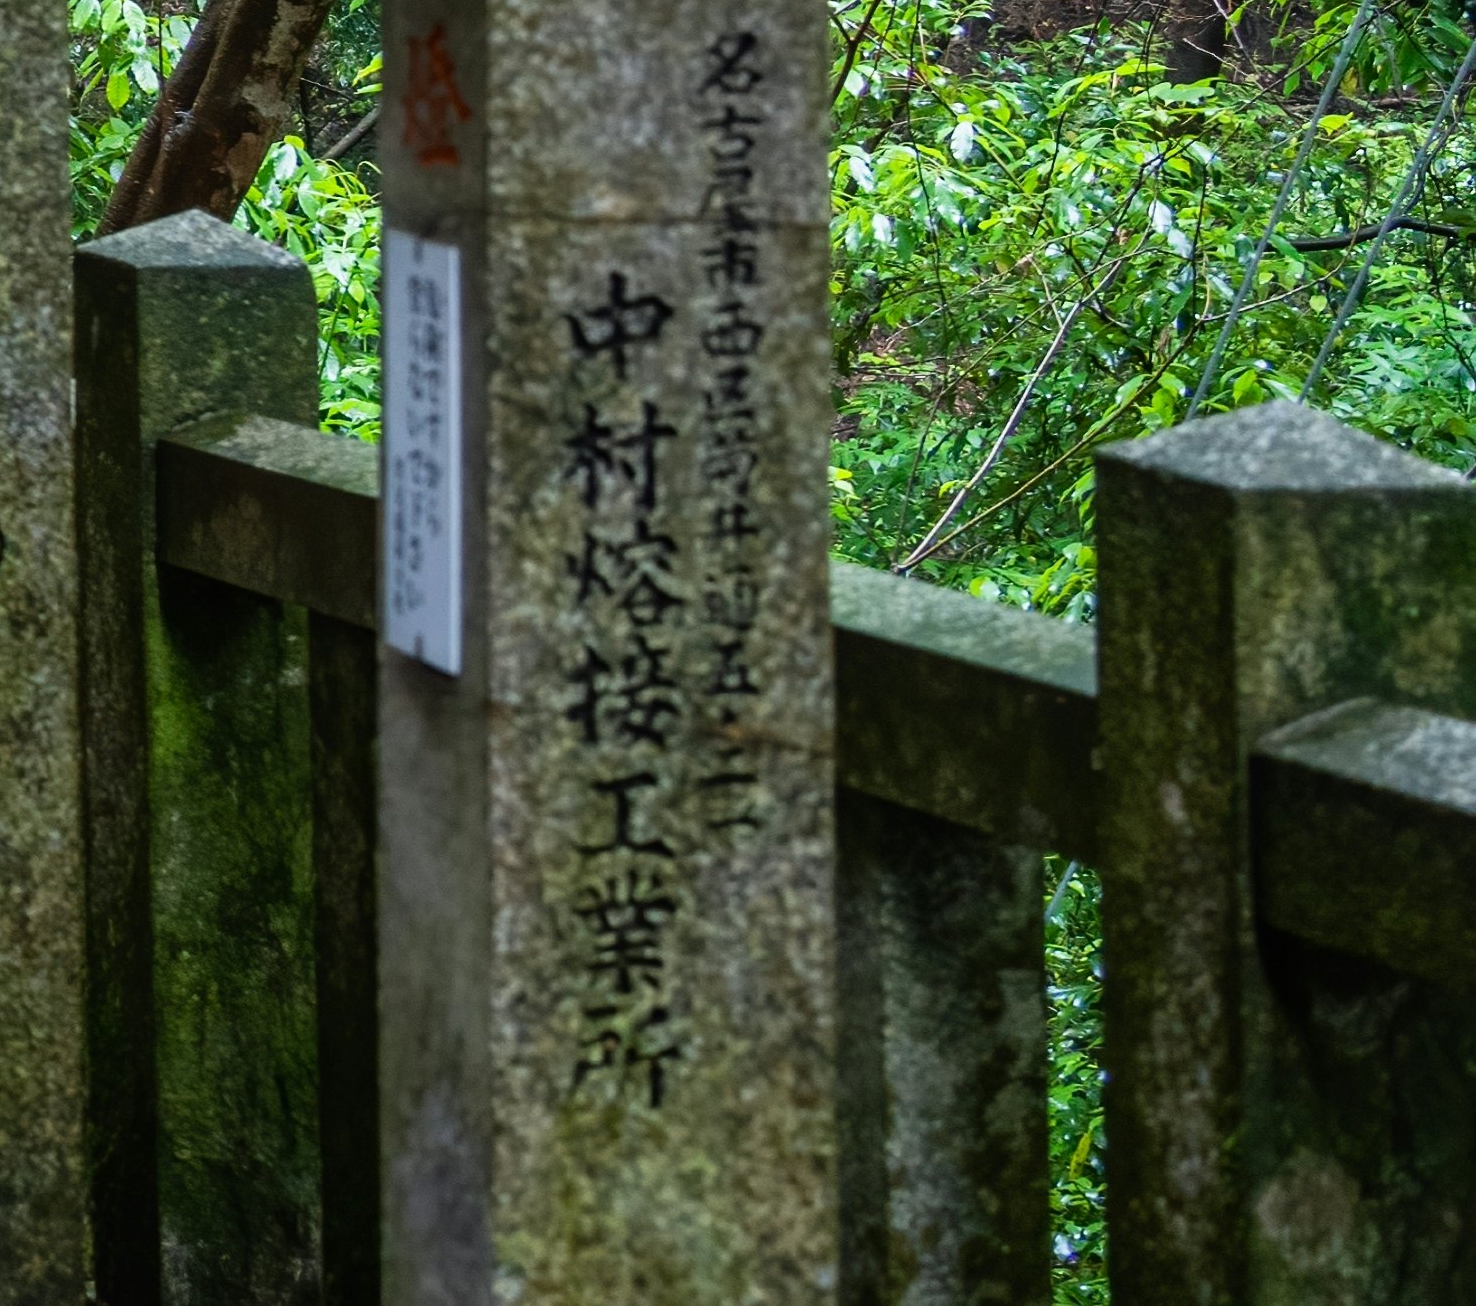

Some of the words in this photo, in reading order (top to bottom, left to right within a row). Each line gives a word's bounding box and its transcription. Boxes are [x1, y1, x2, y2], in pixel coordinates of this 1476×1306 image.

[564, 269, 685, 1110] 中村熔接工業所
